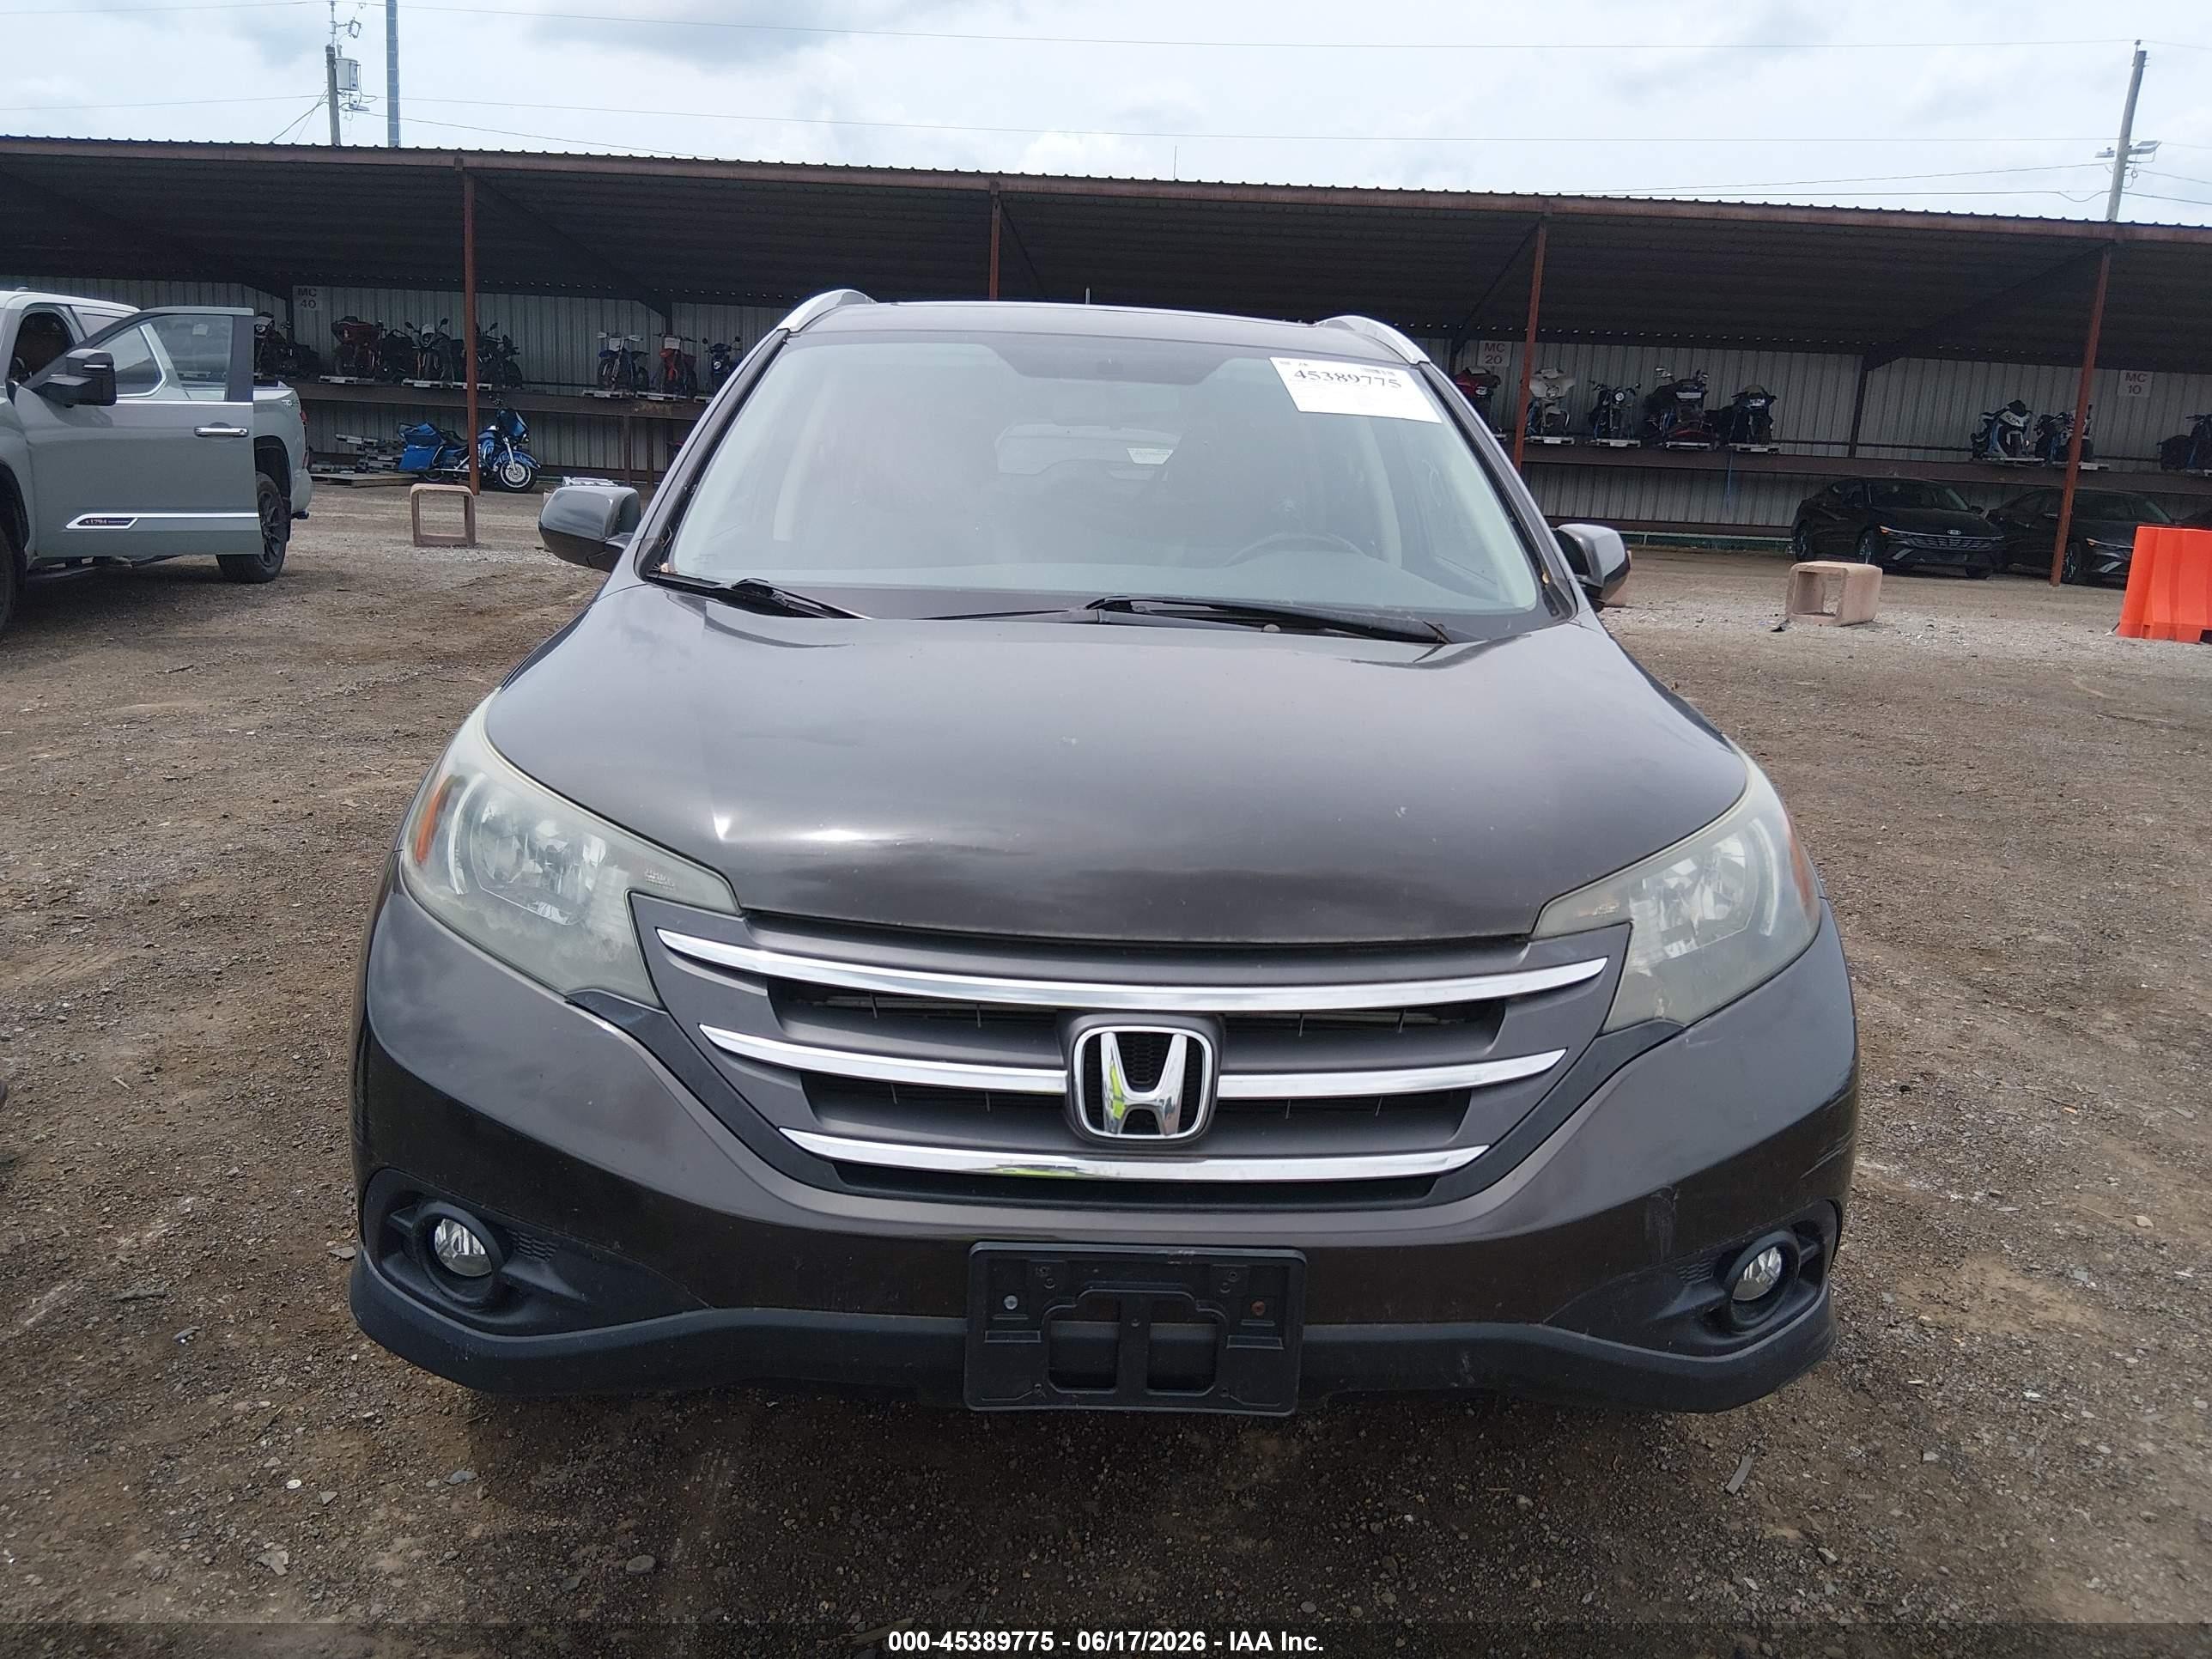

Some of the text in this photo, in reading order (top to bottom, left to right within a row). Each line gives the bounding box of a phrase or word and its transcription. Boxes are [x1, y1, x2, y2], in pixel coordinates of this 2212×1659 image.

[297, 288, 317, 297] MC
[301, 299, 317, 309] 40
[1485, 343, 1505, 352] MC
[1485, 355, 1503, 365] 20
[1293, 369, 1402, 389] 45389775
[2125, 372, 2147, 383] MC
[2128, 384, 2142, 395] 10
